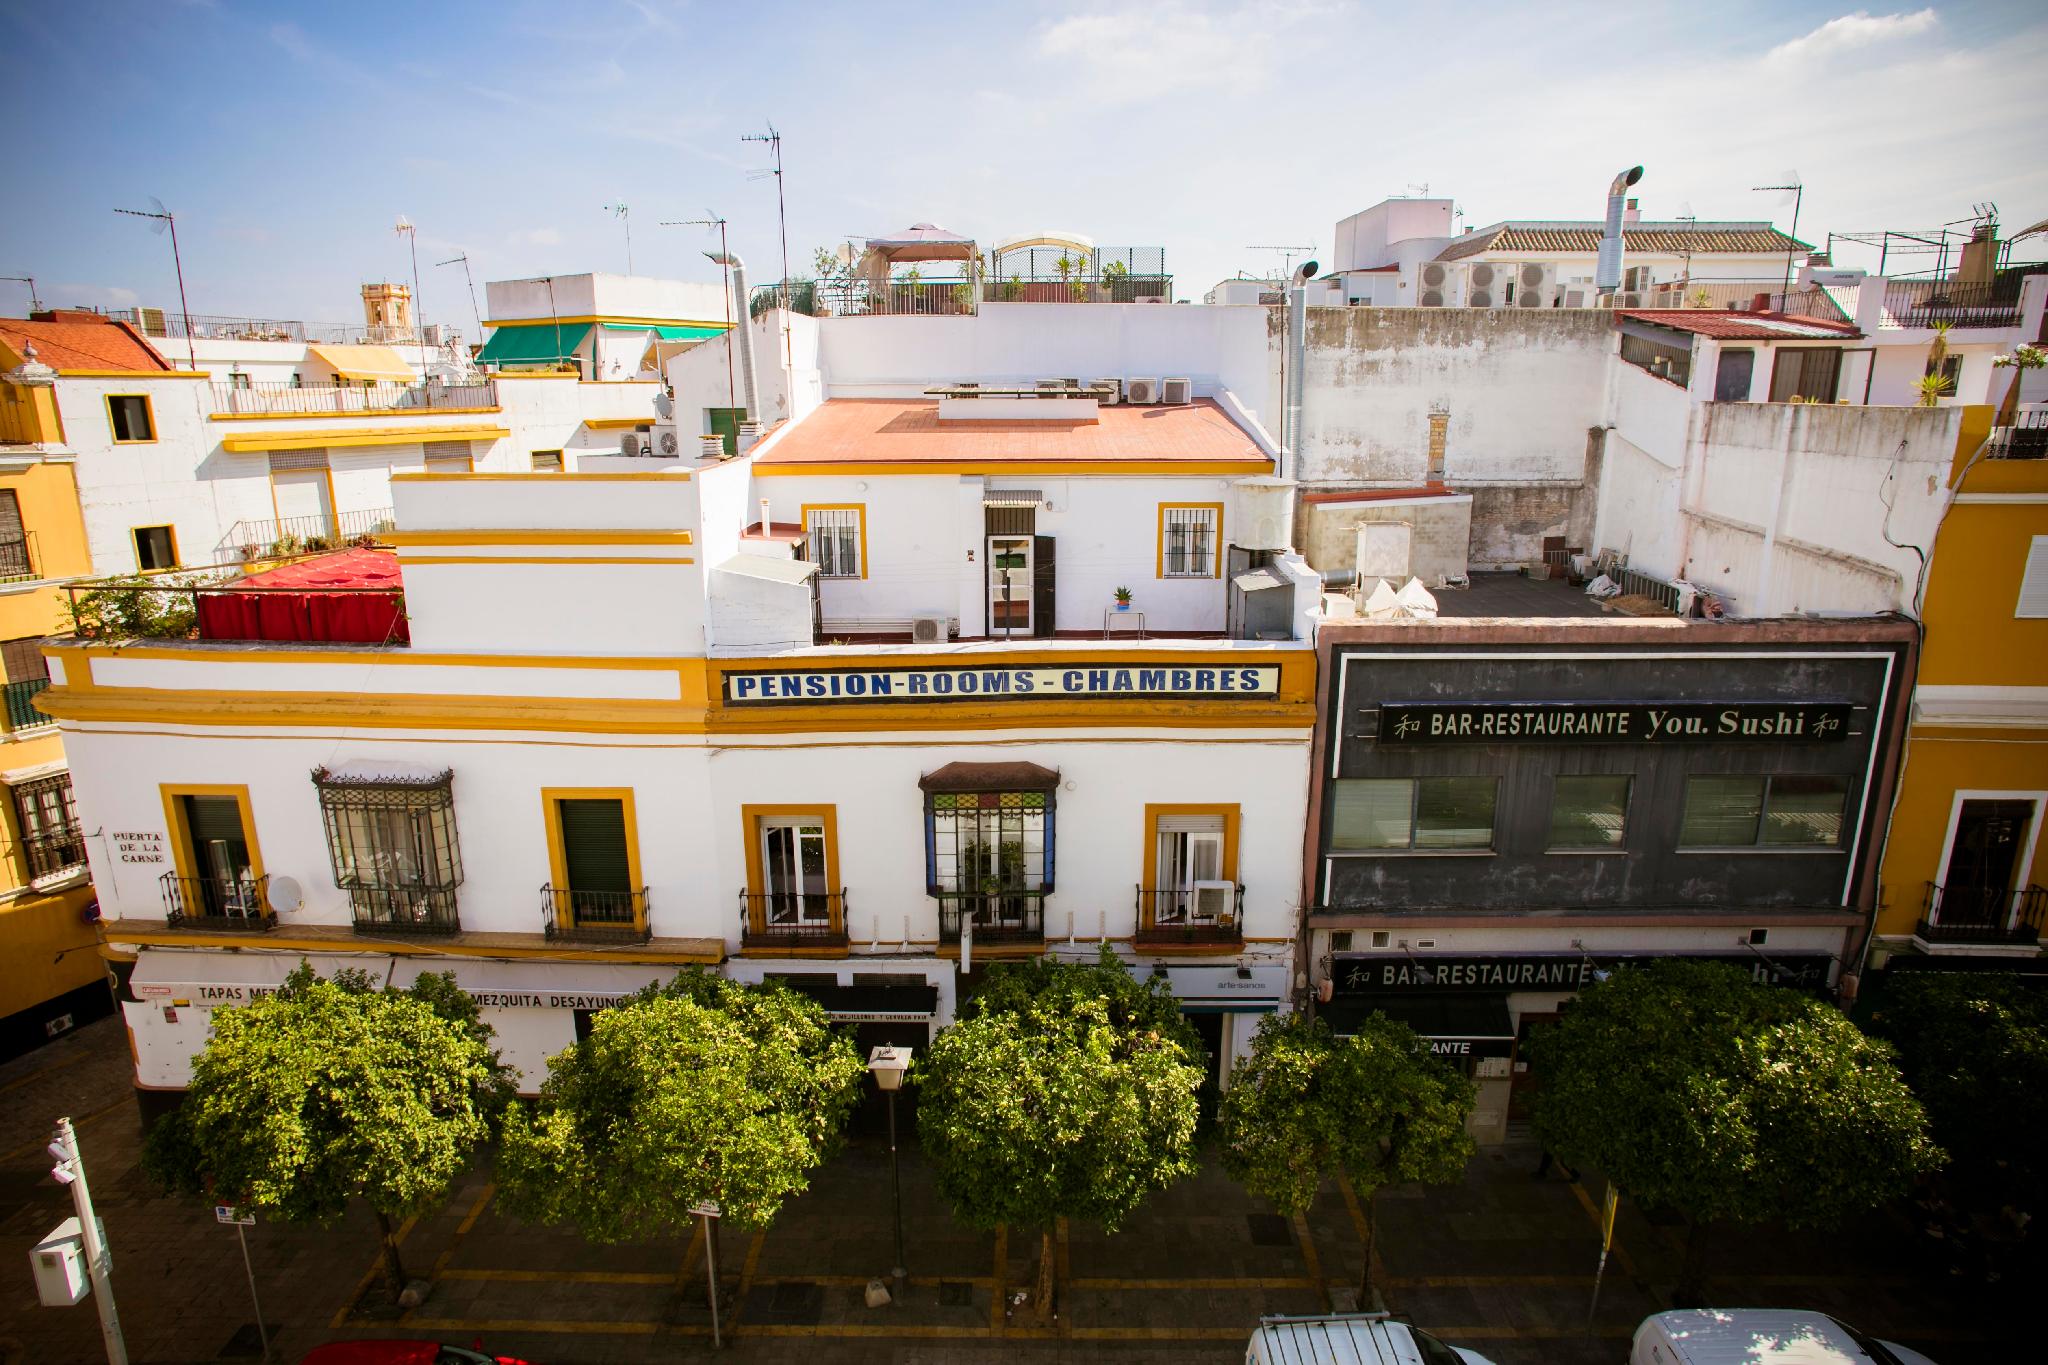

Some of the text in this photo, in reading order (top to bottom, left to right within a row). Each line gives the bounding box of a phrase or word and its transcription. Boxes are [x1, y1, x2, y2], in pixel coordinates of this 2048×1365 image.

[1062, 669, 1259, 693] CHAMBRES
[1431, 713, 1629, 735] BAR-RESTAURANTE
[1718, 711, 1804, 735] Sushi
[113, 832, 161, 841] PUERTA
[120, 843, 160, 852] DE LA
[122, 854, 163, 863] CARNE
[199, 987, 242, 1000] TAPAS
[471, 993, 542, 1008] MEZQUITA
